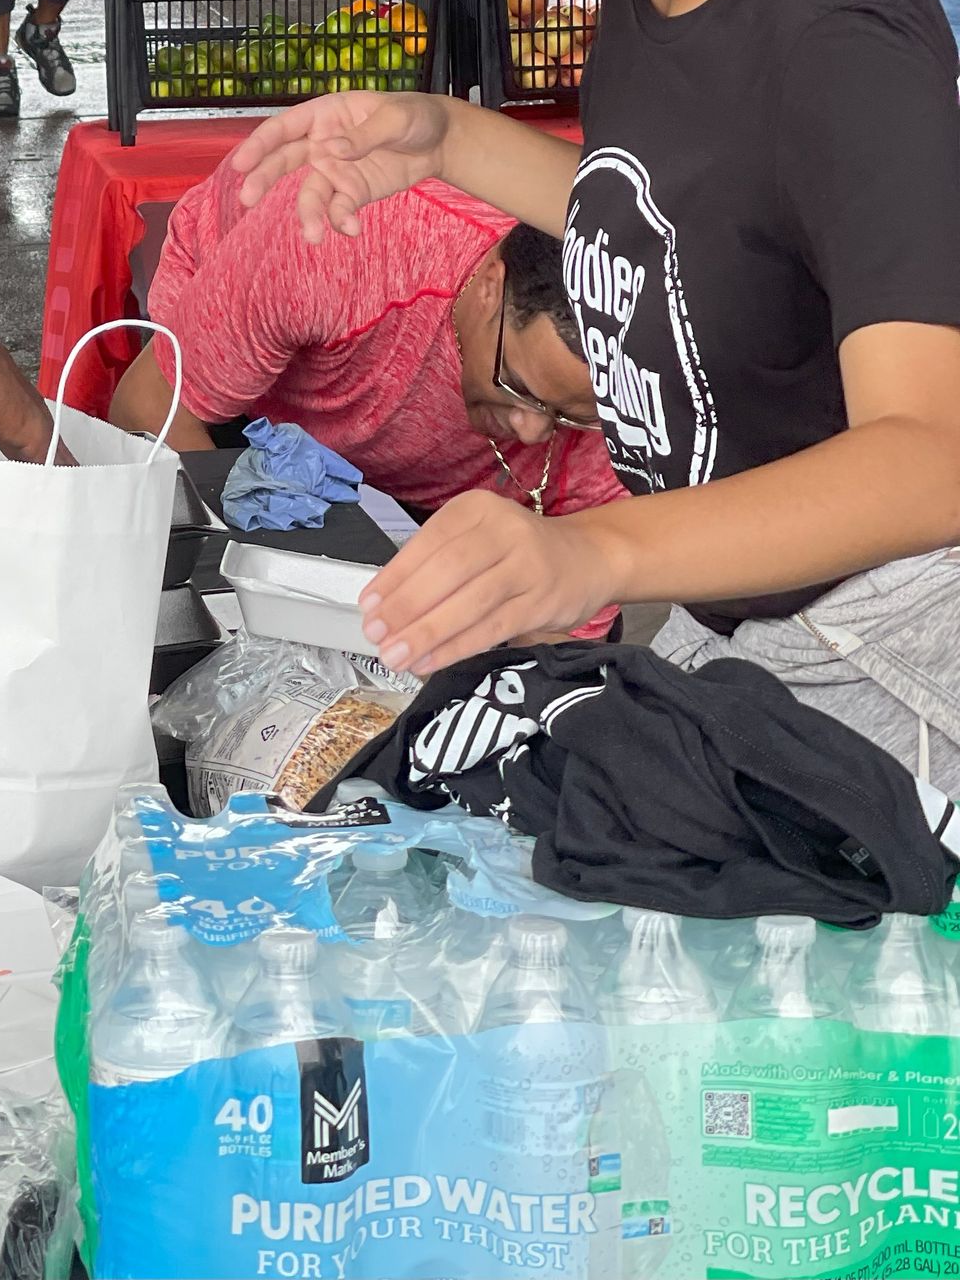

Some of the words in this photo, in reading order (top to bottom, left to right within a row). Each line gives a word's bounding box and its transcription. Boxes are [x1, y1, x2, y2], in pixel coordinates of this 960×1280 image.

[189, 897, 276, 919] 40
[701, 1062, 751, 1077] Made
[753, 1063, 788, 1080] with
[792, 1065, 825, 1081] Our
[828, 1066, 883, 1081] Member
[887, 1070, 900, 1082] &
[214, 1094, 274, 1134] 40
[243, 1134, 256, 1144] FL
[218, 1145, 272, 1158] BOTTLES
[306, 1138, 366, 1166] Member's
[323, 1162, 353, 1180] Mark
[231, 1175, 431, 1244] PURIFIED
[436, 1176, 597, 1235] WATER
[257, 1249, 322, 1279] FOR
[331, 1216, 423, 1280] YOUR
[434, 1217, 568, 1271] THIRST
[704, 1230, 774, 1265] FOR
[783, 1229, 851, 1265] THE
[894, 1239, 913, 1255] mL
